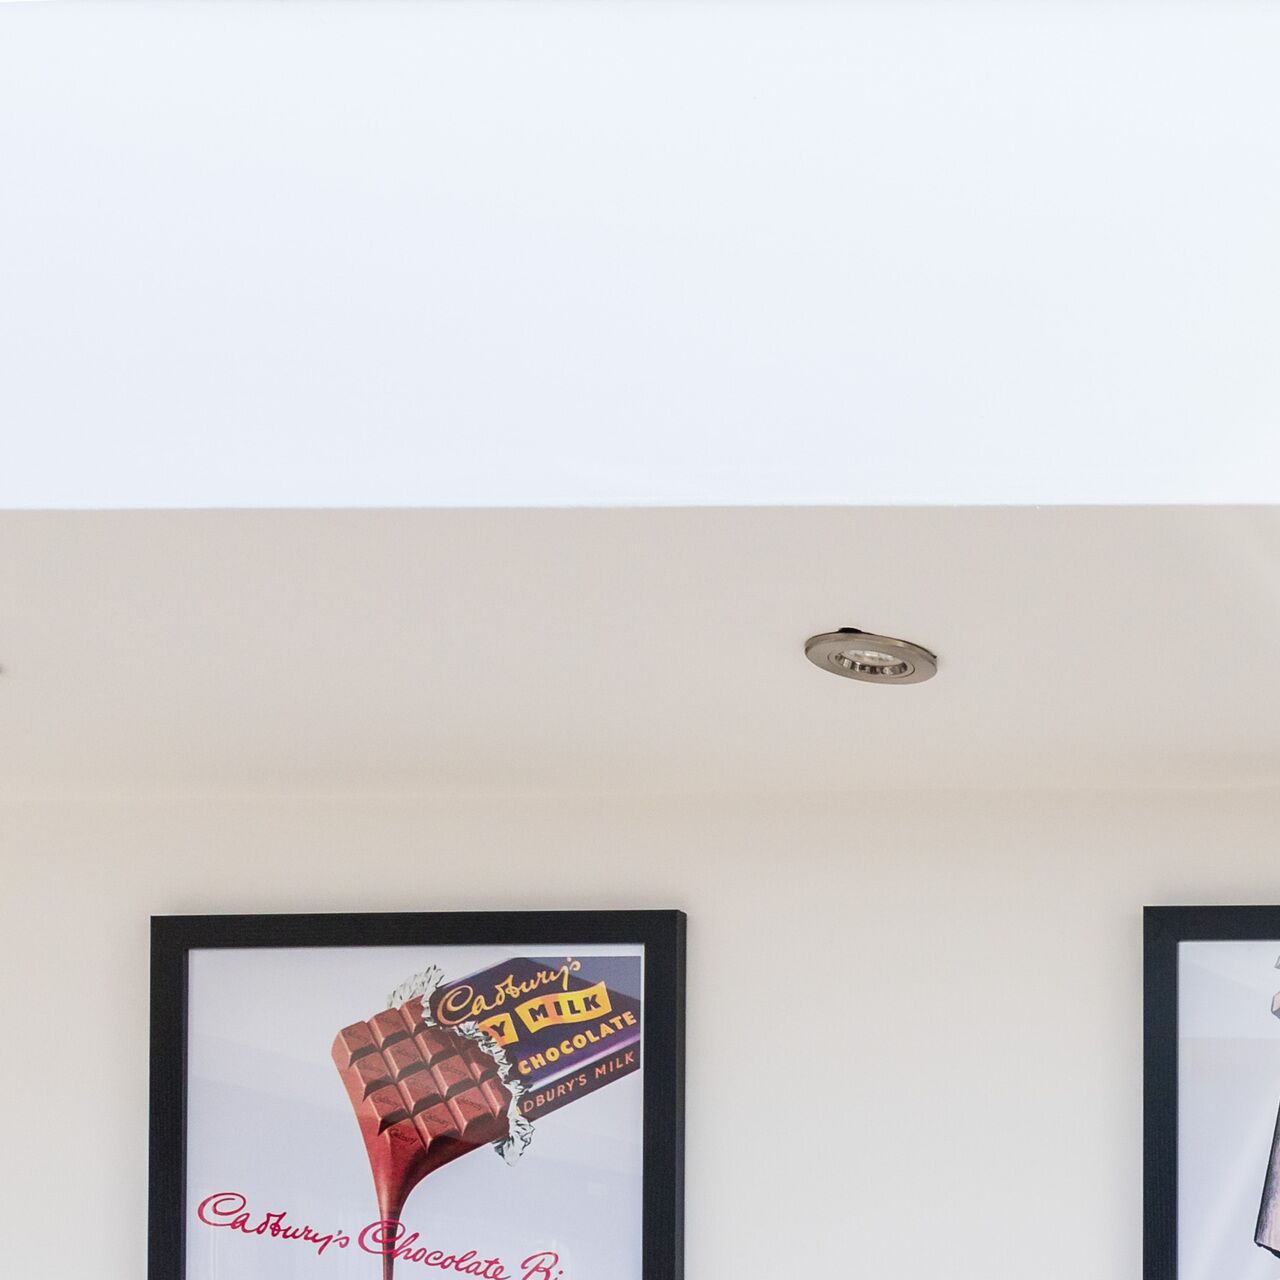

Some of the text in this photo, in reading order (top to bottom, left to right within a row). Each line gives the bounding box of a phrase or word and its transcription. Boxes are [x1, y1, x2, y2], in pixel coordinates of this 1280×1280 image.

[437, 956, 582, 1026] Cadbury's
[529, 993, 603, 1022] MILK
[518, 1011, 638, 1076] CHOCOLATE
[594, 1051, 635, 1079] MILK
[197, 1192, 349, 1256] Cadbury's
